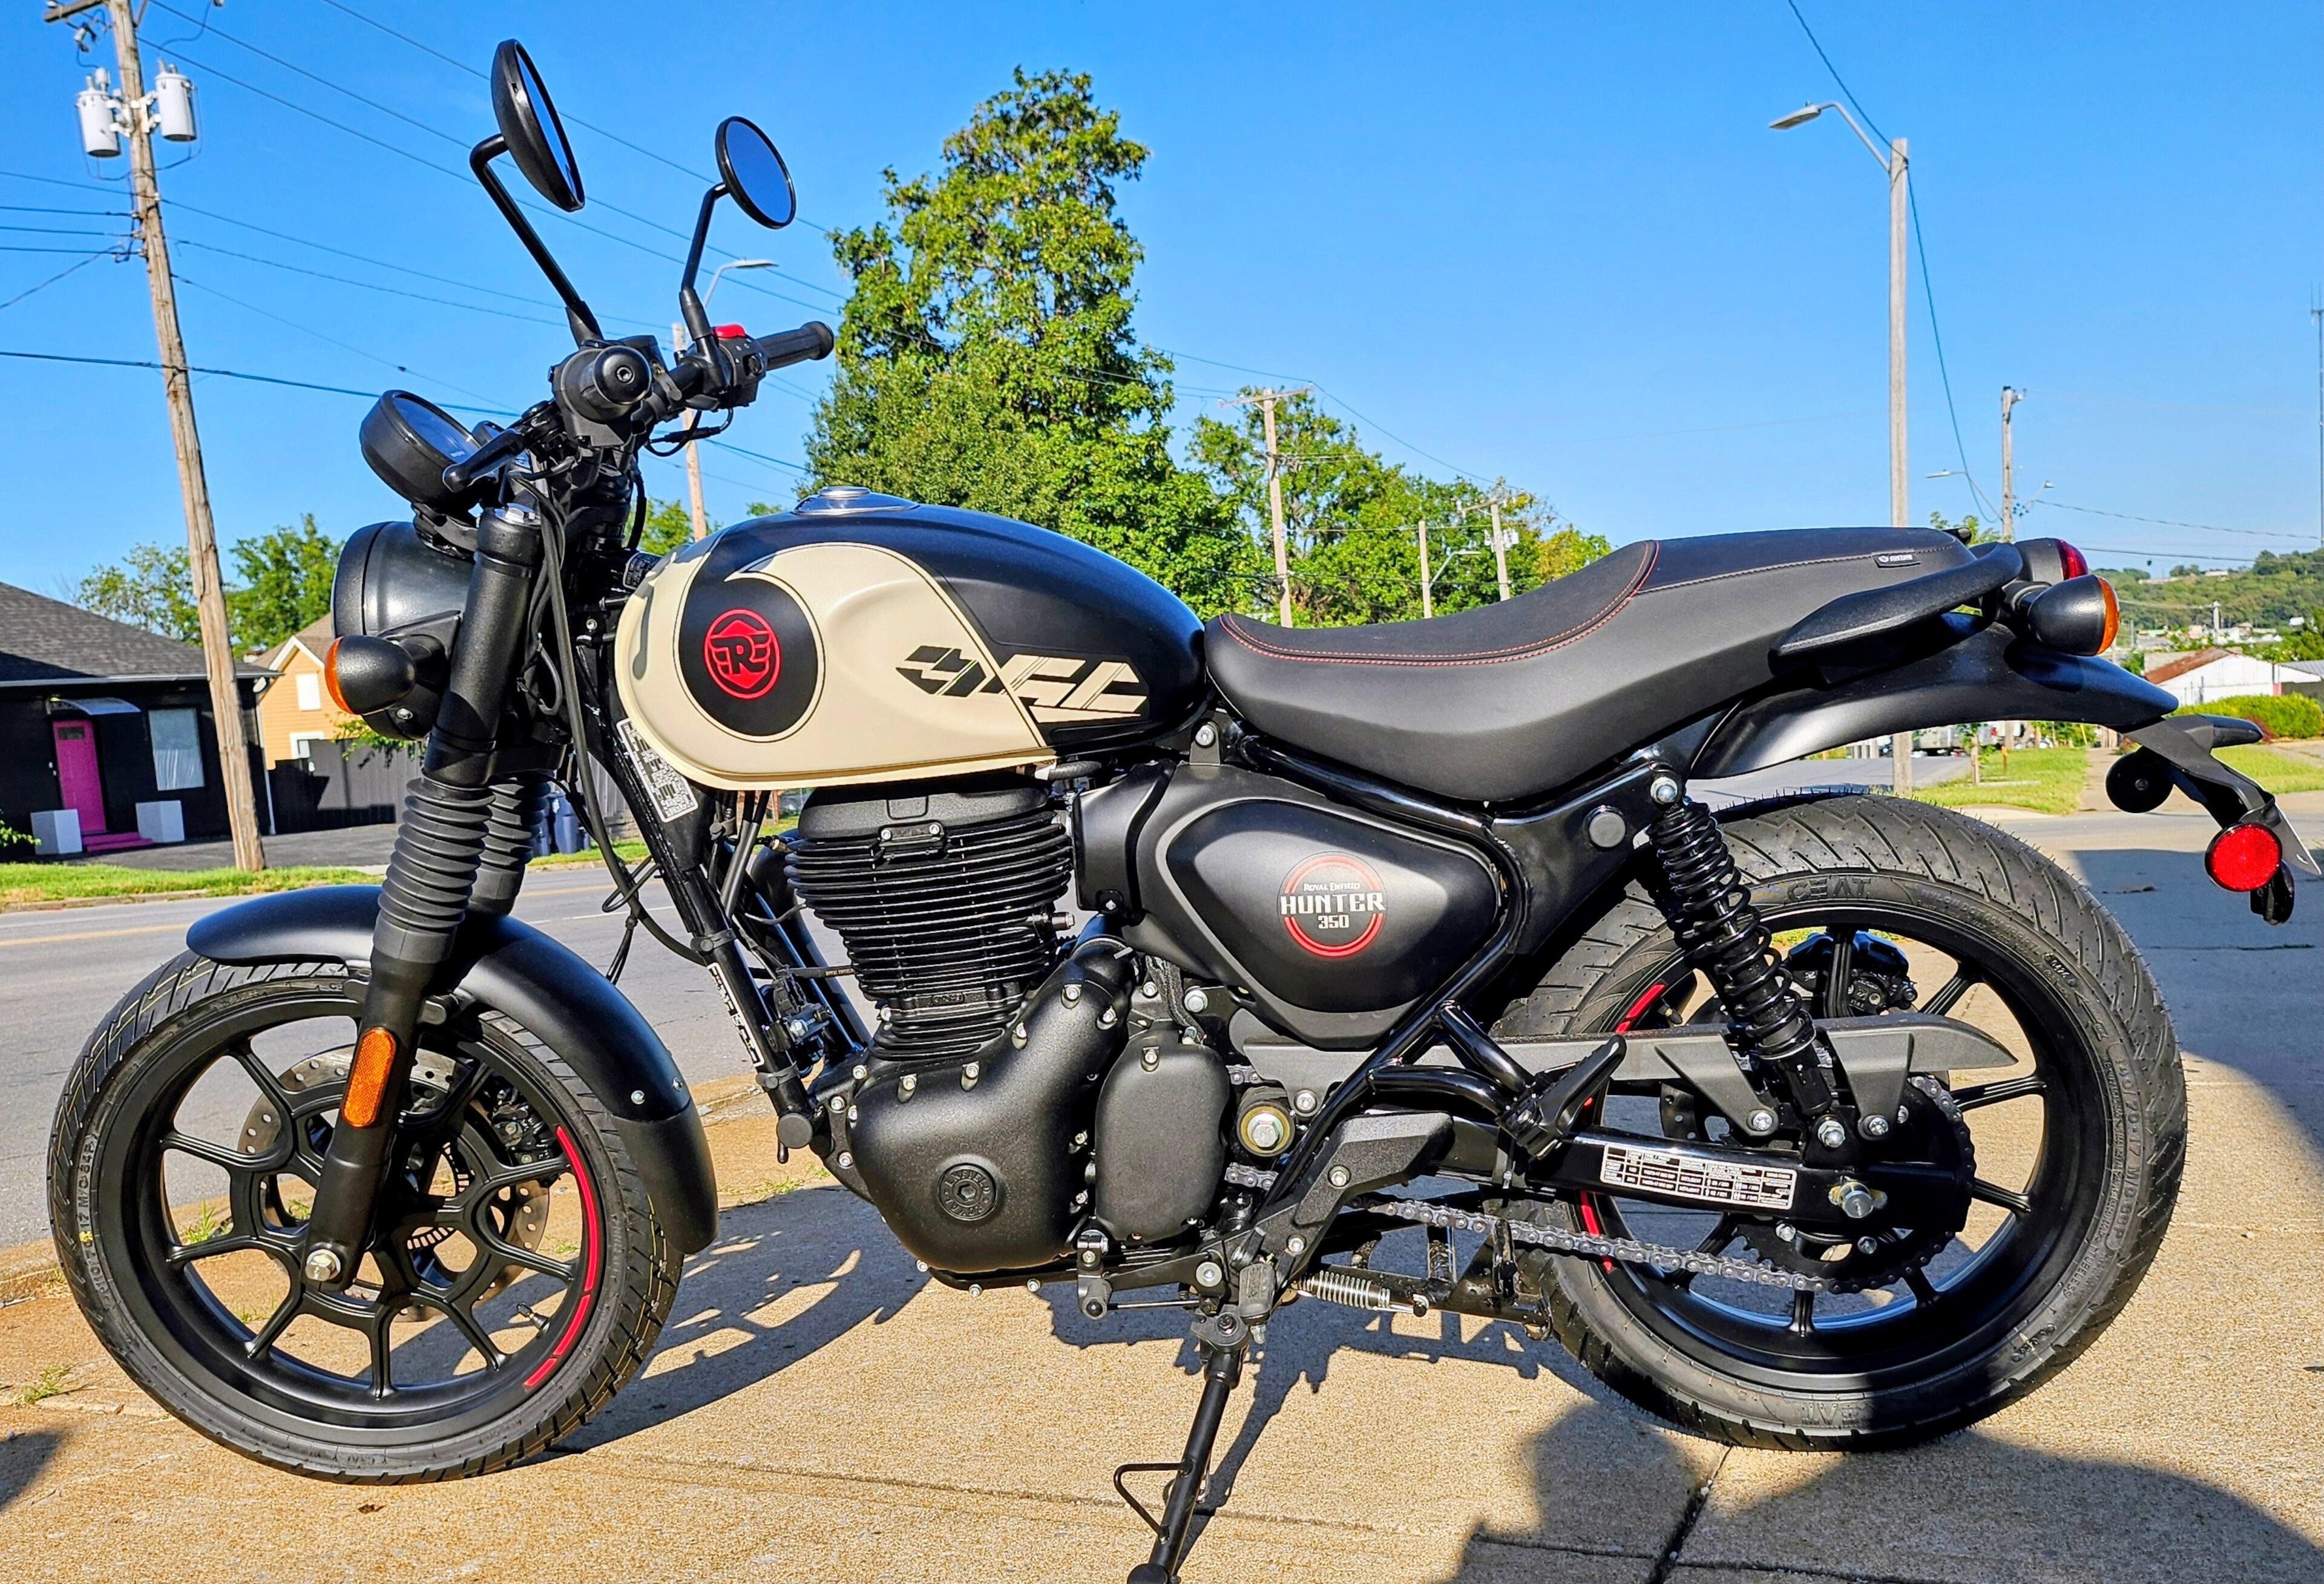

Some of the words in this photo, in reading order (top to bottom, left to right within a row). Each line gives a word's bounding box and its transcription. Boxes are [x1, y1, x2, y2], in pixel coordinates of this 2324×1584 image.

[1303, 882, 1328, 892] ROYAL
[1330, 881, 1361, 891] ENFIELD
[1787, 877, 1871, 901] CEAT
[1280, 892, 1386, 915] HUNTER
[1318, 914, 1350, 929] 350
[2063, 1247, 2098, 1298] TUBELESS
